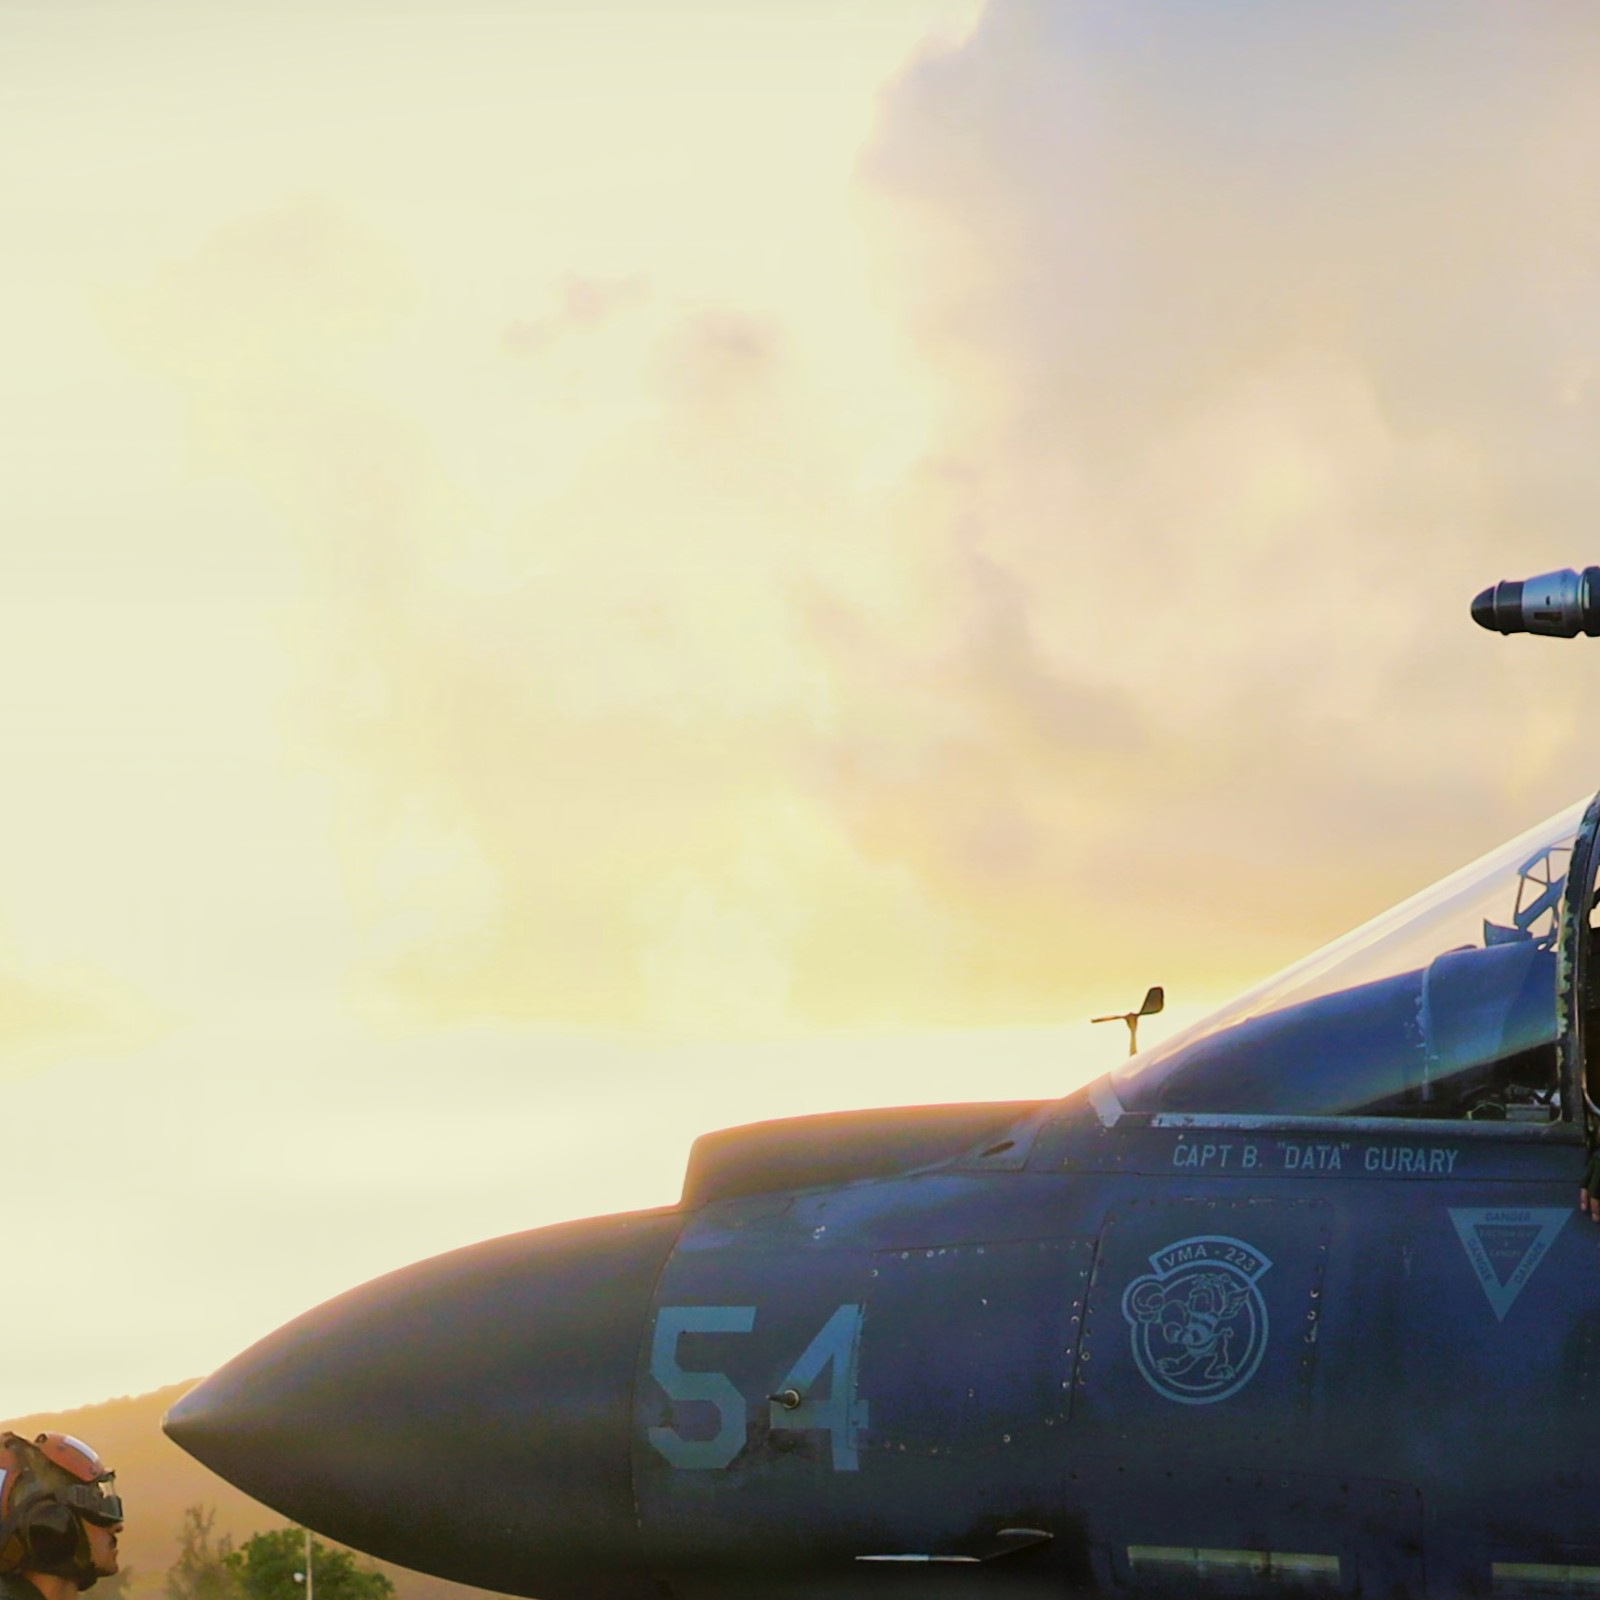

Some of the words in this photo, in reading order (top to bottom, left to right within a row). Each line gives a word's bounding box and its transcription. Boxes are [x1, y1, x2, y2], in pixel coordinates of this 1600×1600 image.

[1172, 1144, 1232, 1168] CAPT
[1241, 1146, 1264, 1169] B.
[1276, 1142, 1350, 1170] "DATA"
[1364, 1147, 1459, 1173] GURARY
[1485, 1210, 1532, 1223] DANGER
[1162, 1244, 1208, 1268] VMA
[1223, 1246, 1257, 1273] 223
[647, 1303, 871, 1472] 54
